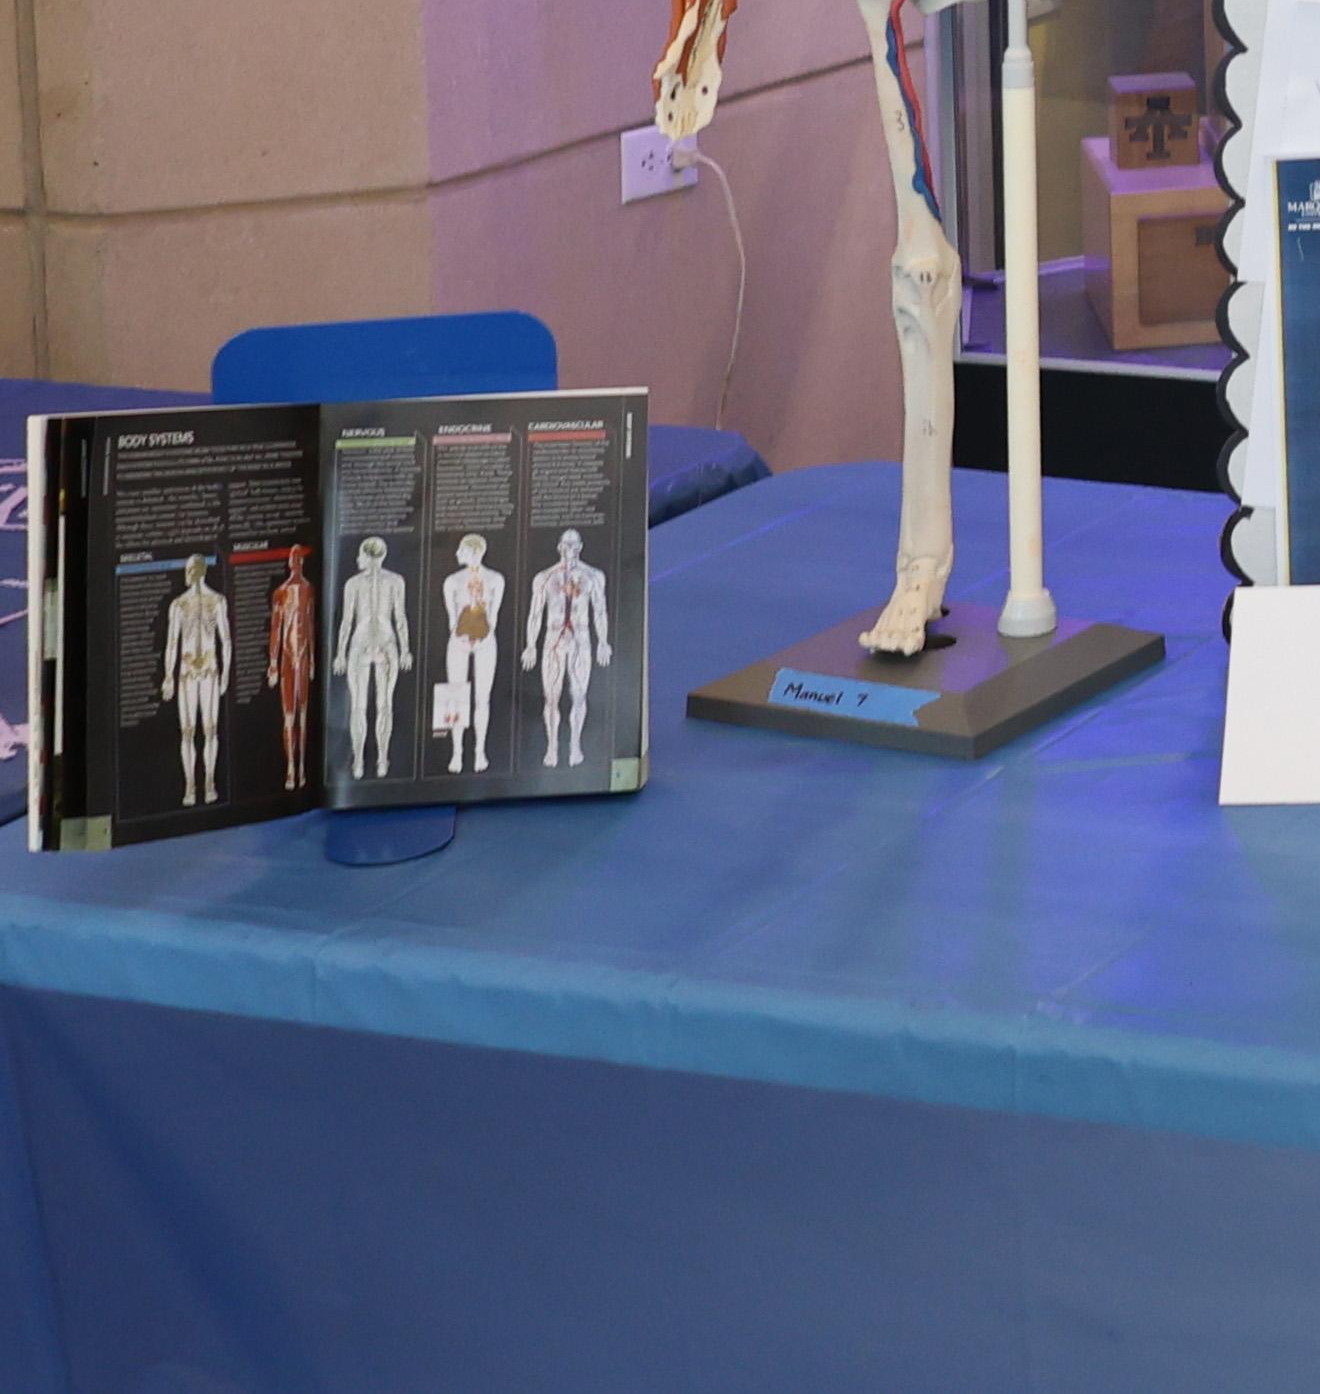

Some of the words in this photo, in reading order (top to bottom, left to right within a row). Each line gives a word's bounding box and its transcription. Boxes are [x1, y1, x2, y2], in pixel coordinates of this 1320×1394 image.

[117, 434, 147, 449] BODY
[149, 430, 194, 447] SYSTEMS
[783, 682, 843, 705] Manuel
